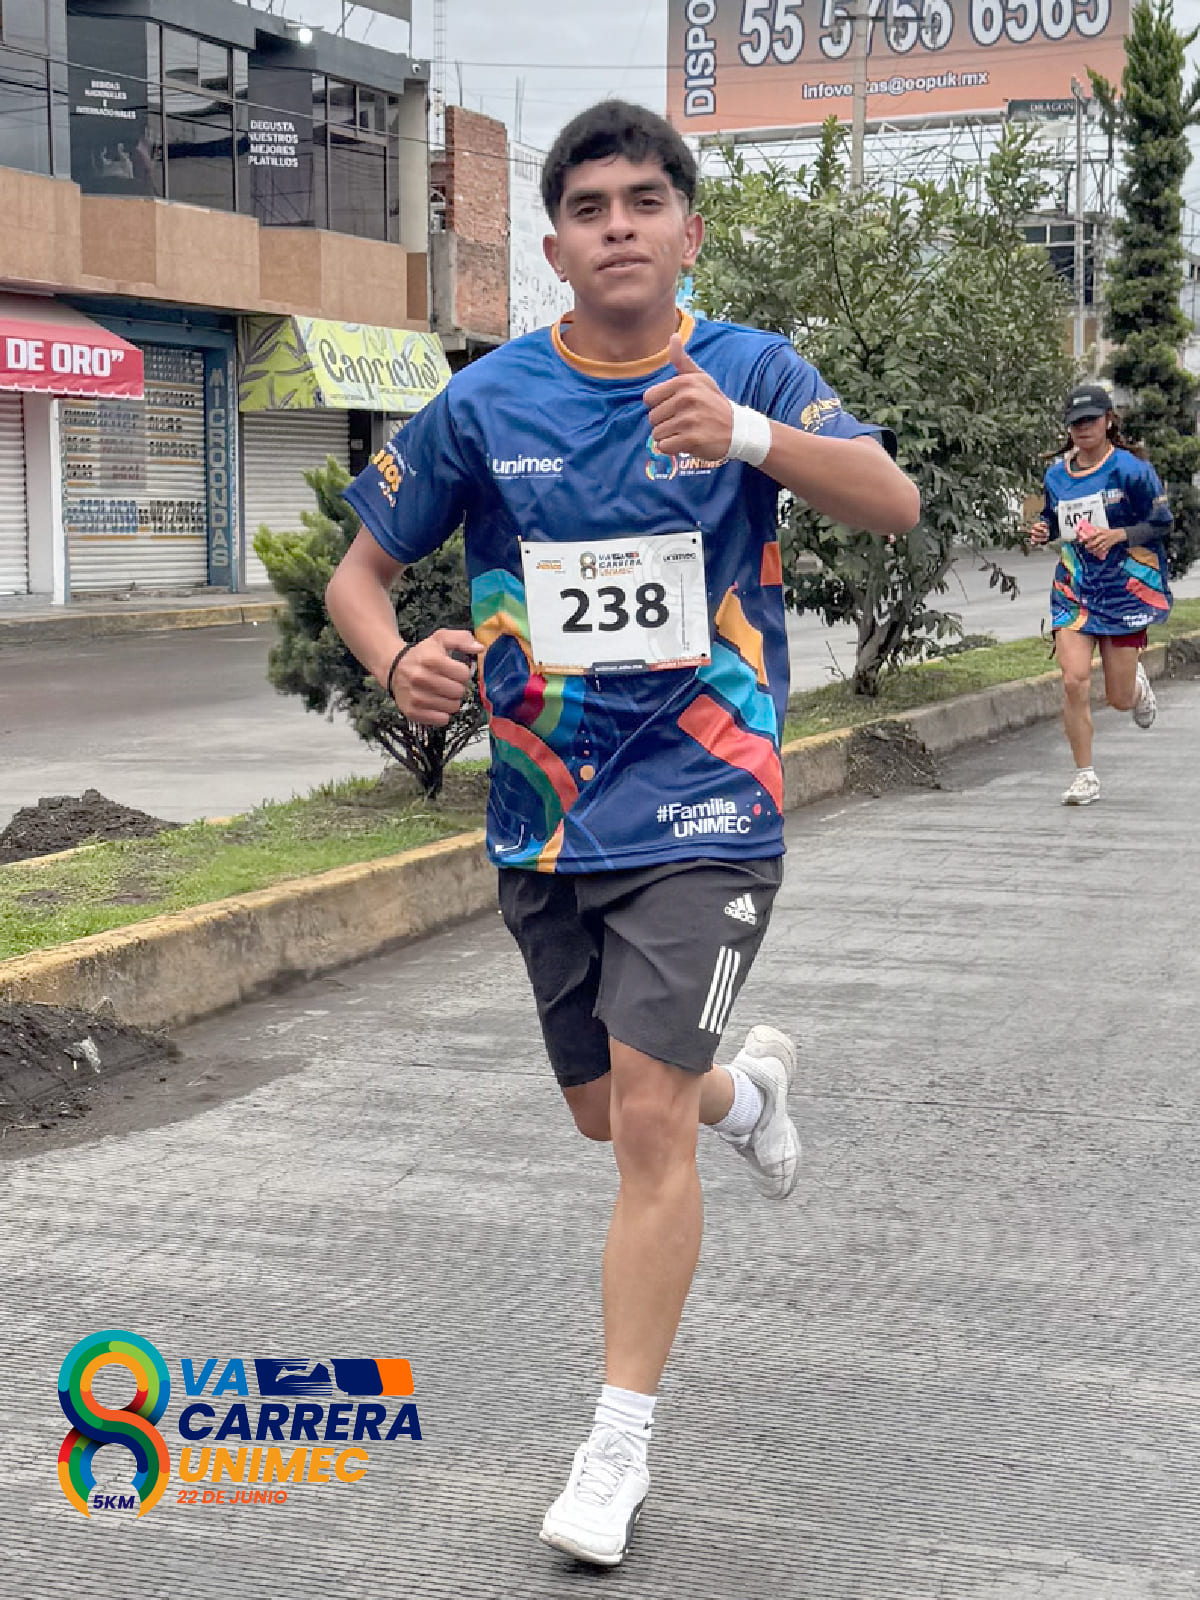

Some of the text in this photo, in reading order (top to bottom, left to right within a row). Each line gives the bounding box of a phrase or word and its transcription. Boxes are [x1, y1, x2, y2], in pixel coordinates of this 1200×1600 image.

[738, 0, 805, 66] 55
[250, 119, 295, 132] DEGUSTA
[248, 132, 299, 144] NUESTROS
[250, 143, 296, 156] MEJORES
[248, 155, 299, 168] PLATILLOS
[6, 337, 45, 371] DE
[319, 338, 440, 401] Capricho
[492, 453, 564, 474] unimec
[559, 582, 670, 634] 238
[656, 797, 738, 823] #Familia
[673, 815, 752, 838] UNIMEC
